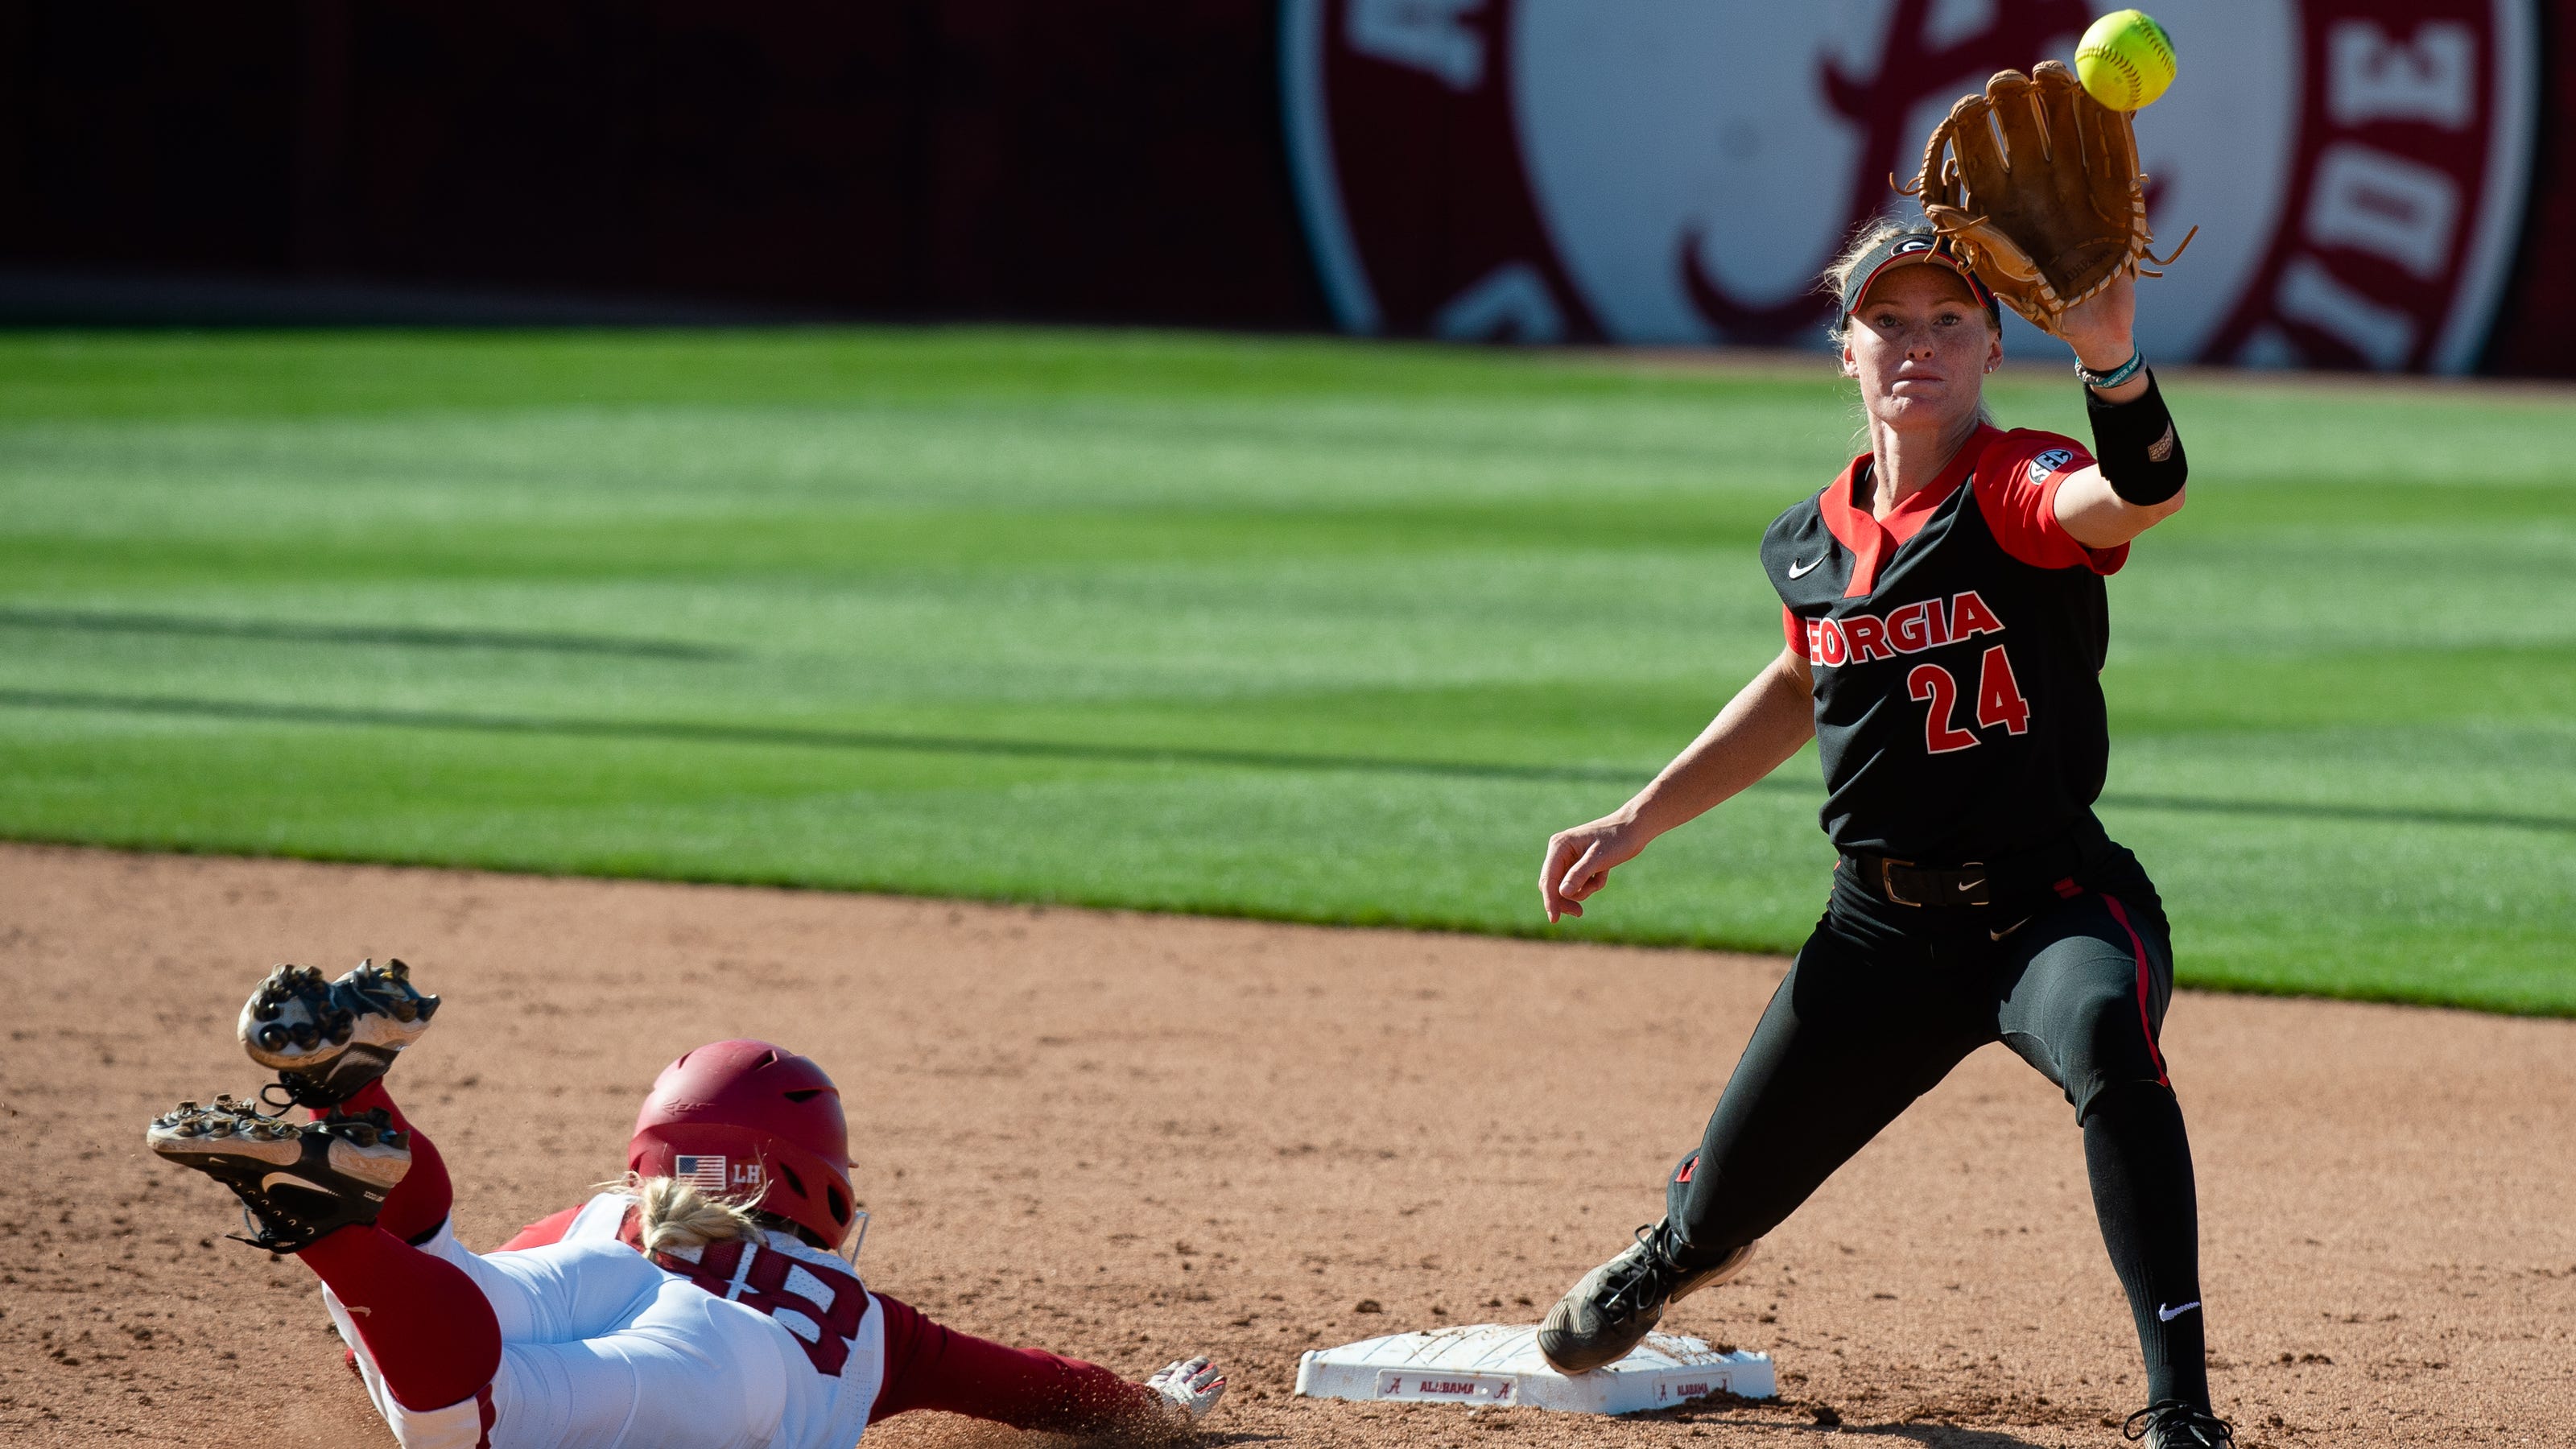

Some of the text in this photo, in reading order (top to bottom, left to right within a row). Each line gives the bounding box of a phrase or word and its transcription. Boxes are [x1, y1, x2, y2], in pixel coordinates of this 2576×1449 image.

[2103, 368, 2129, 388] CANCER
[2029, 449, 2074, 485] SEC
[1806, 590, 2006, 668] EORGIA
[1907, 644, 2030, 754] 24
[733, 1164, 761, 1183] LH
